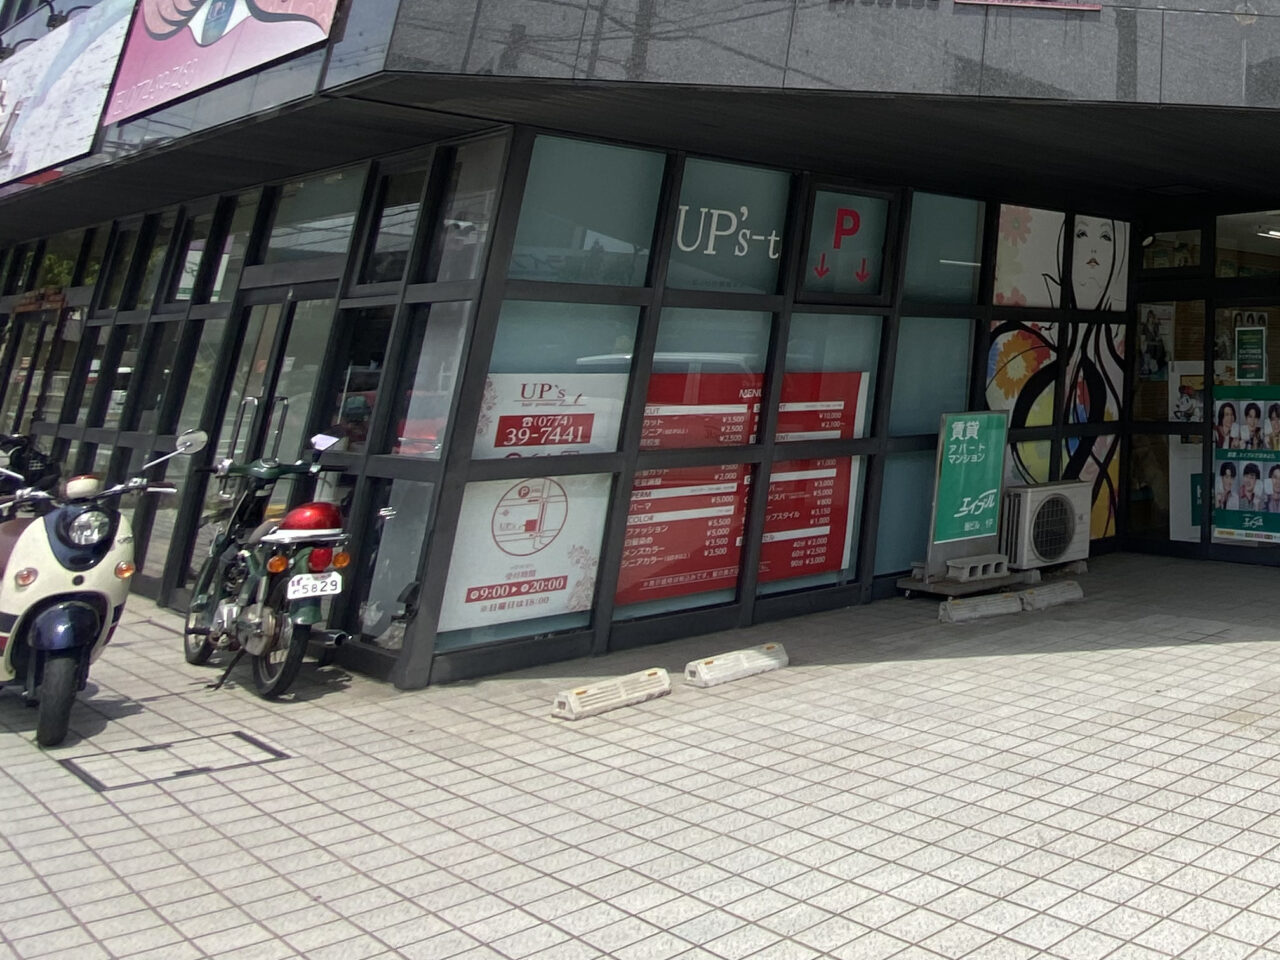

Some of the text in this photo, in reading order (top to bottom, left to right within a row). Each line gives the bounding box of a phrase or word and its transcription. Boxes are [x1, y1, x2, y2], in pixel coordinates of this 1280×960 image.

[833, 208, 861, 250] P
[534, 416, 573, 427] (0774)
[504, 427, 583, 446] 39-7441
[949, 443, 986, 453] アパート
[948, 453, 985, 464] マンション
[953, 489, 998, 518] エイブル
[302, 580, 338, 594] 5829
